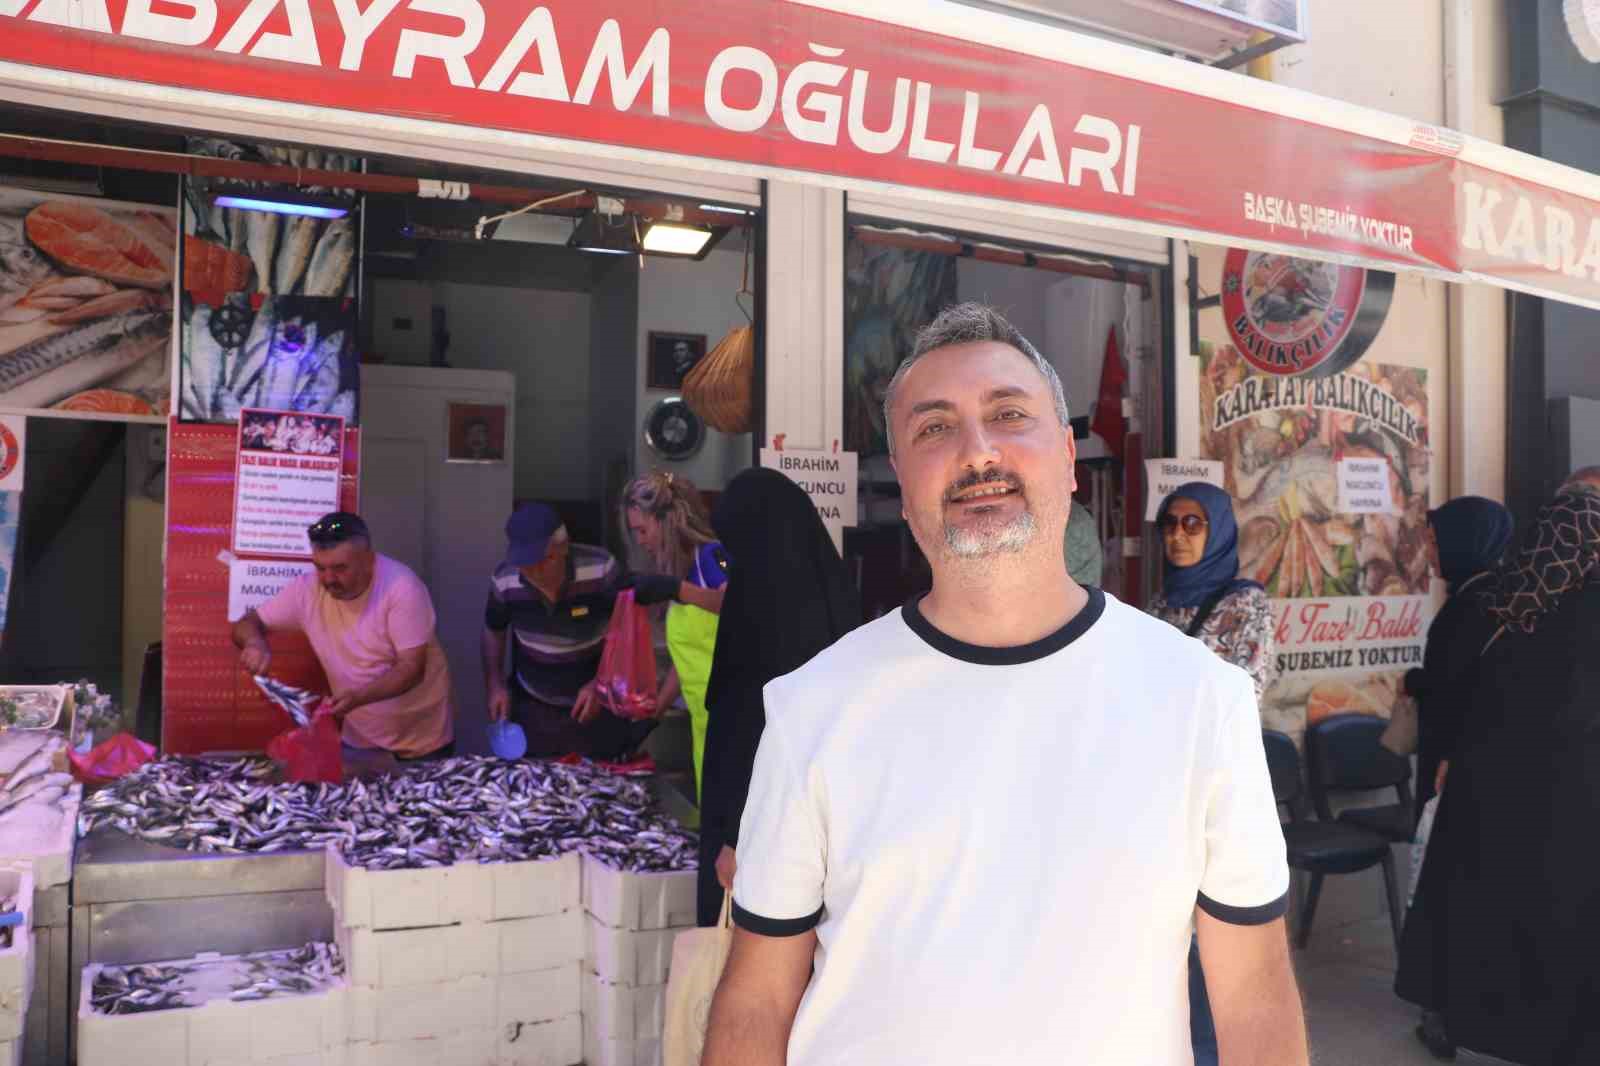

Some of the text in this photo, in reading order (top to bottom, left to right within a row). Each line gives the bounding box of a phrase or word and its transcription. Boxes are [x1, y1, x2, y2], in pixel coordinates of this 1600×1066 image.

[704, 43, 1141, 197] OĞULLARI
[1244, 192, 1298, 233] BAŞKA
[1360, 216, 1414, 251] YOKTUR
[1313, 371, 1418, 444] BALIKÇILIK
[779, 454, 839, 471] İBRAHİM
[1275, 645, 1421, 677] ŞUBEMİZ YOKTUR
